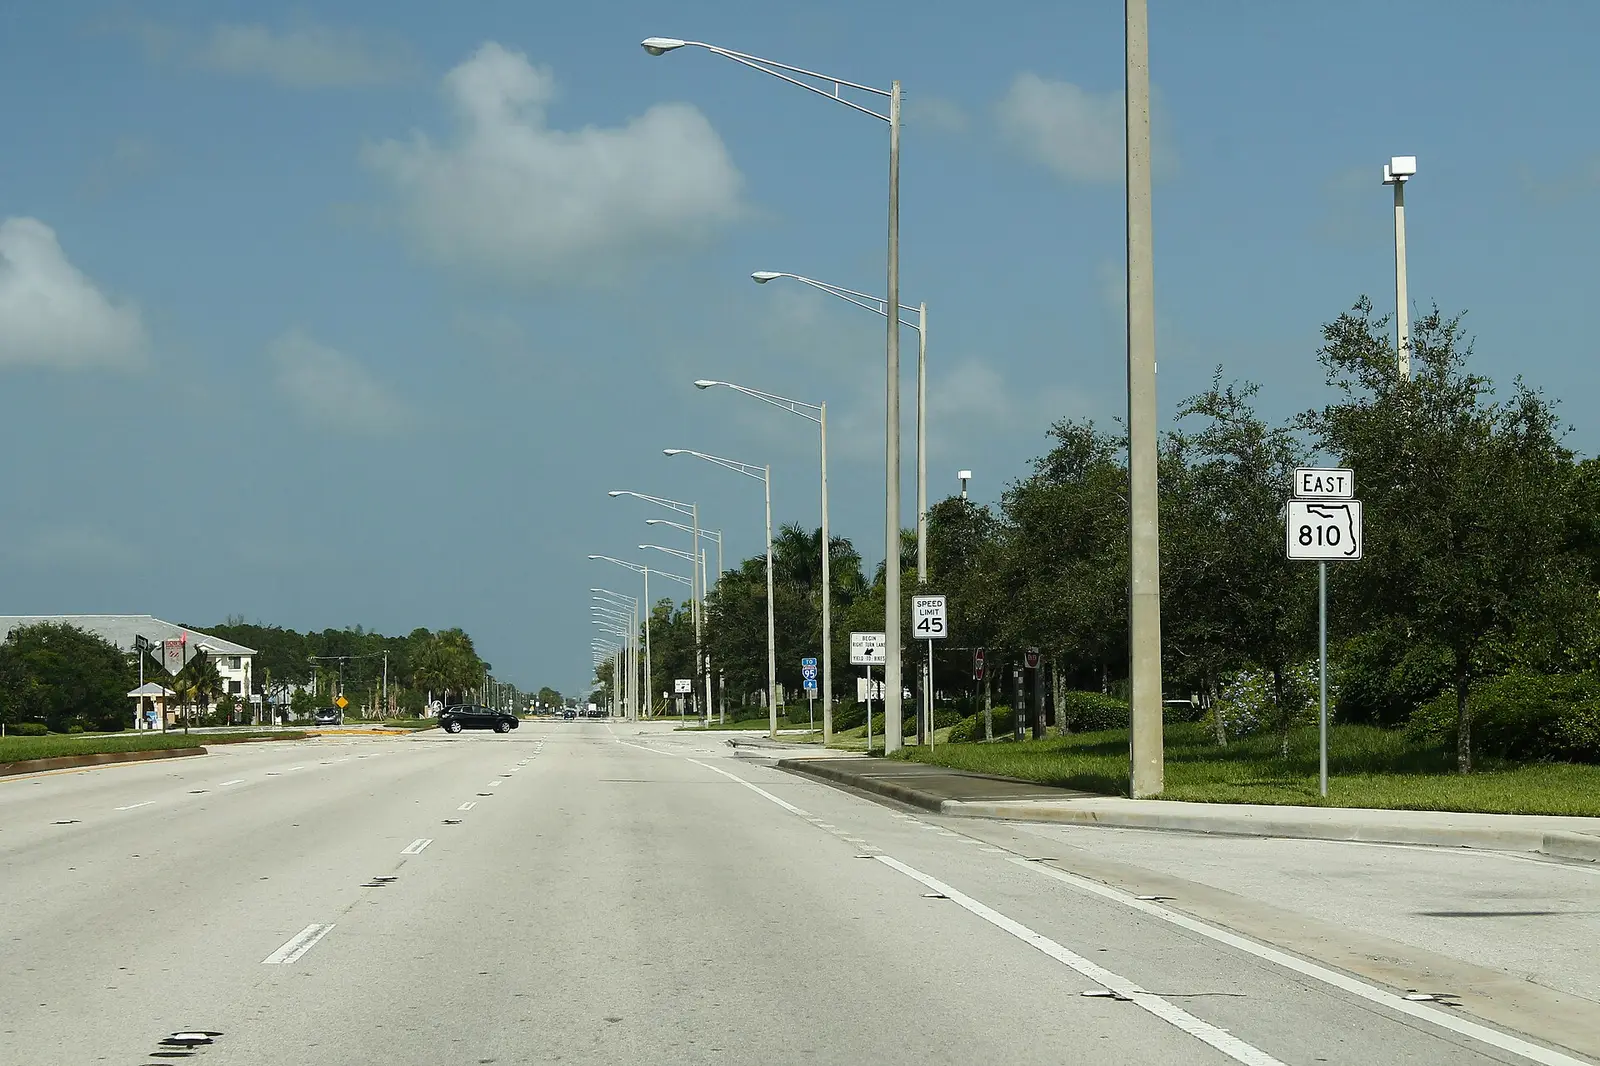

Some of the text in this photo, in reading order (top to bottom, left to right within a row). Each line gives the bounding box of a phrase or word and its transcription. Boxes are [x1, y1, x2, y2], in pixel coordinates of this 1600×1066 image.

[1303, 474, 1344, 493] EAST
[1299, 525, 1341, 546] 810
[917, 600, 943, 608] SPEED
[919, 608, 940, 616] LIMIT
[917, 617, 943, 632] 45
[804, 670, 815, 678] 95
